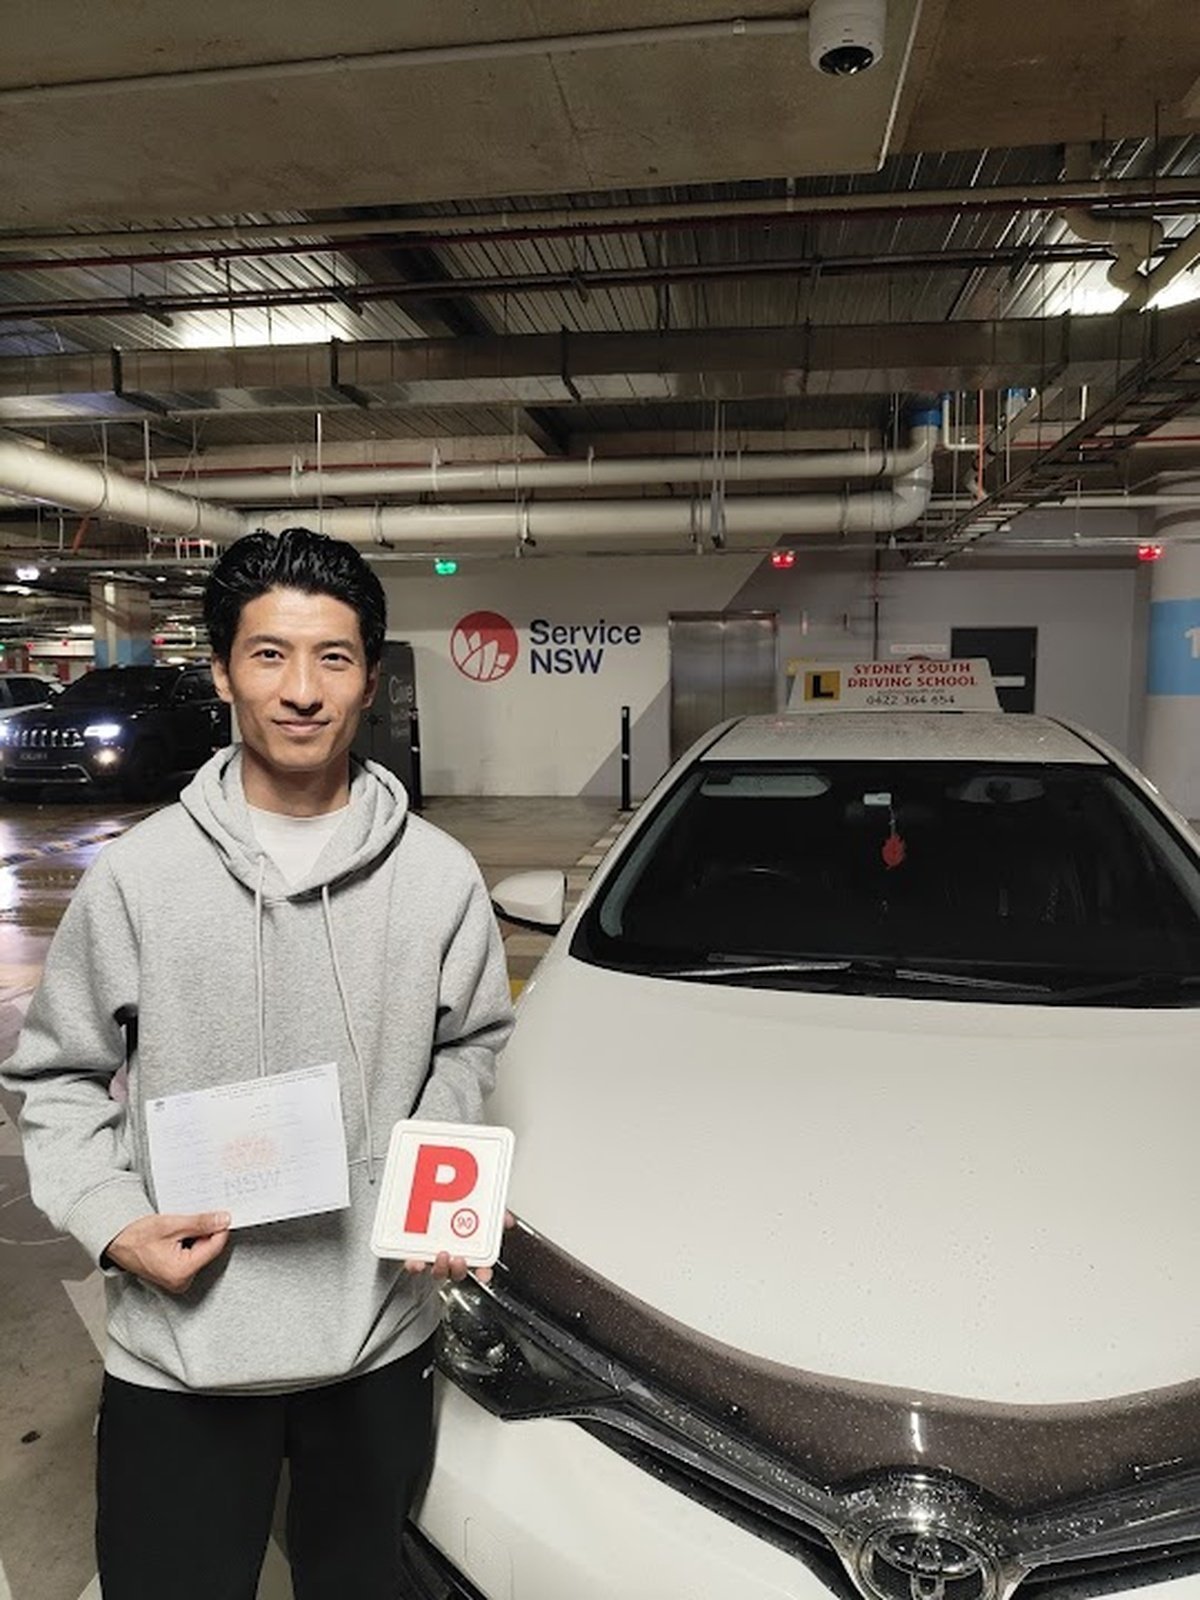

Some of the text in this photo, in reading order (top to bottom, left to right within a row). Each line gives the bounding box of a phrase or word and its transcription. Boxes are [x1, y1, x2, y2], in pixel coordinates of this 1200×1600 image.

[529, 618, 642, 645] Service
[530, 648, 604, 674] NSW
[853, 662, 971, 675] SYDNEY SOUTH
[812, 675, 834, 698] L
[847, 675, 978, 688] DRIVING SCHOOL
[404, 1143, 479, 1234] P
